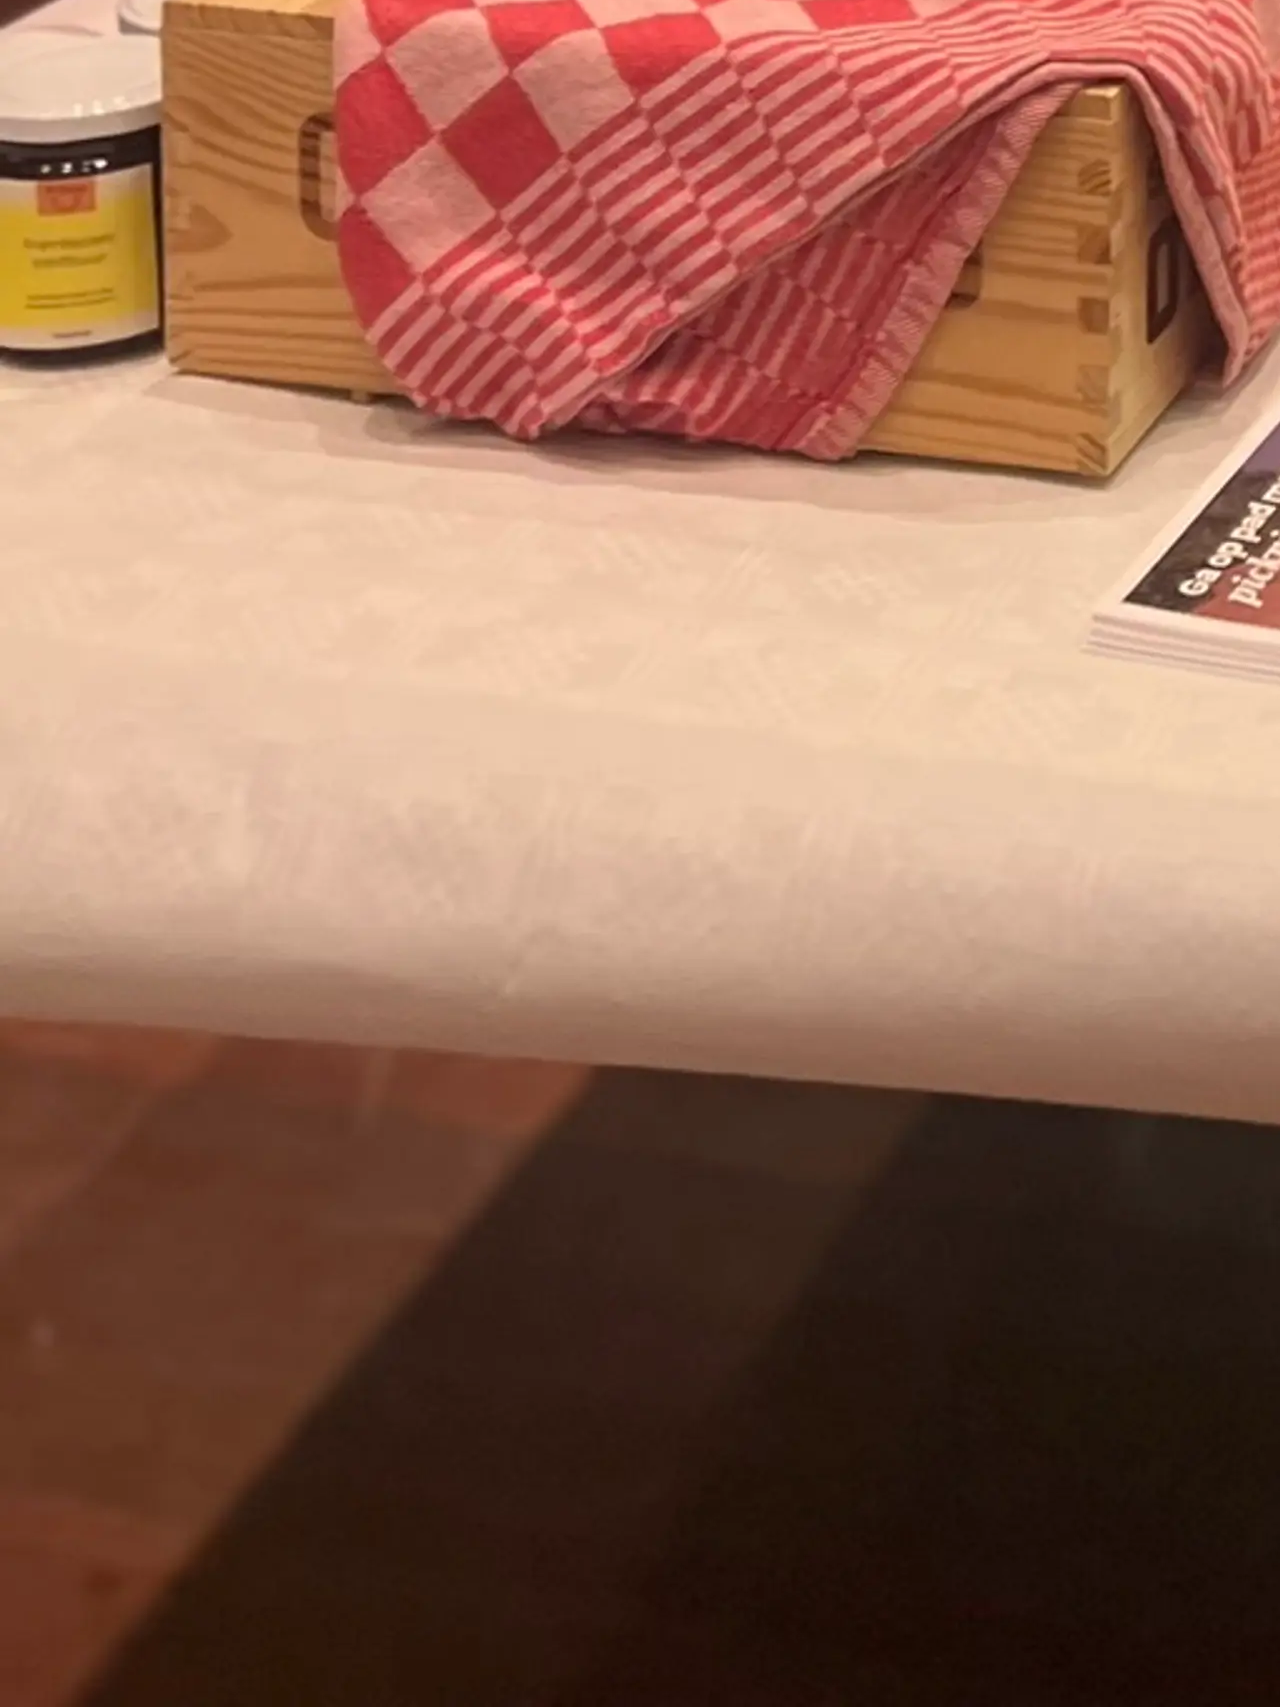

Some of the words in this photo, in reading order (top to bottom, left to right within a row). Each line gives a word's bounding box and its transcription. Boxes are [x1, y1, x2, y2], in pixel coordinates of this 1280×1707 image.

[1178, 567, 1221, 596] Ga
[1208, 541, 1248, 567] op
[1231, 501, 1277, 543] pad
